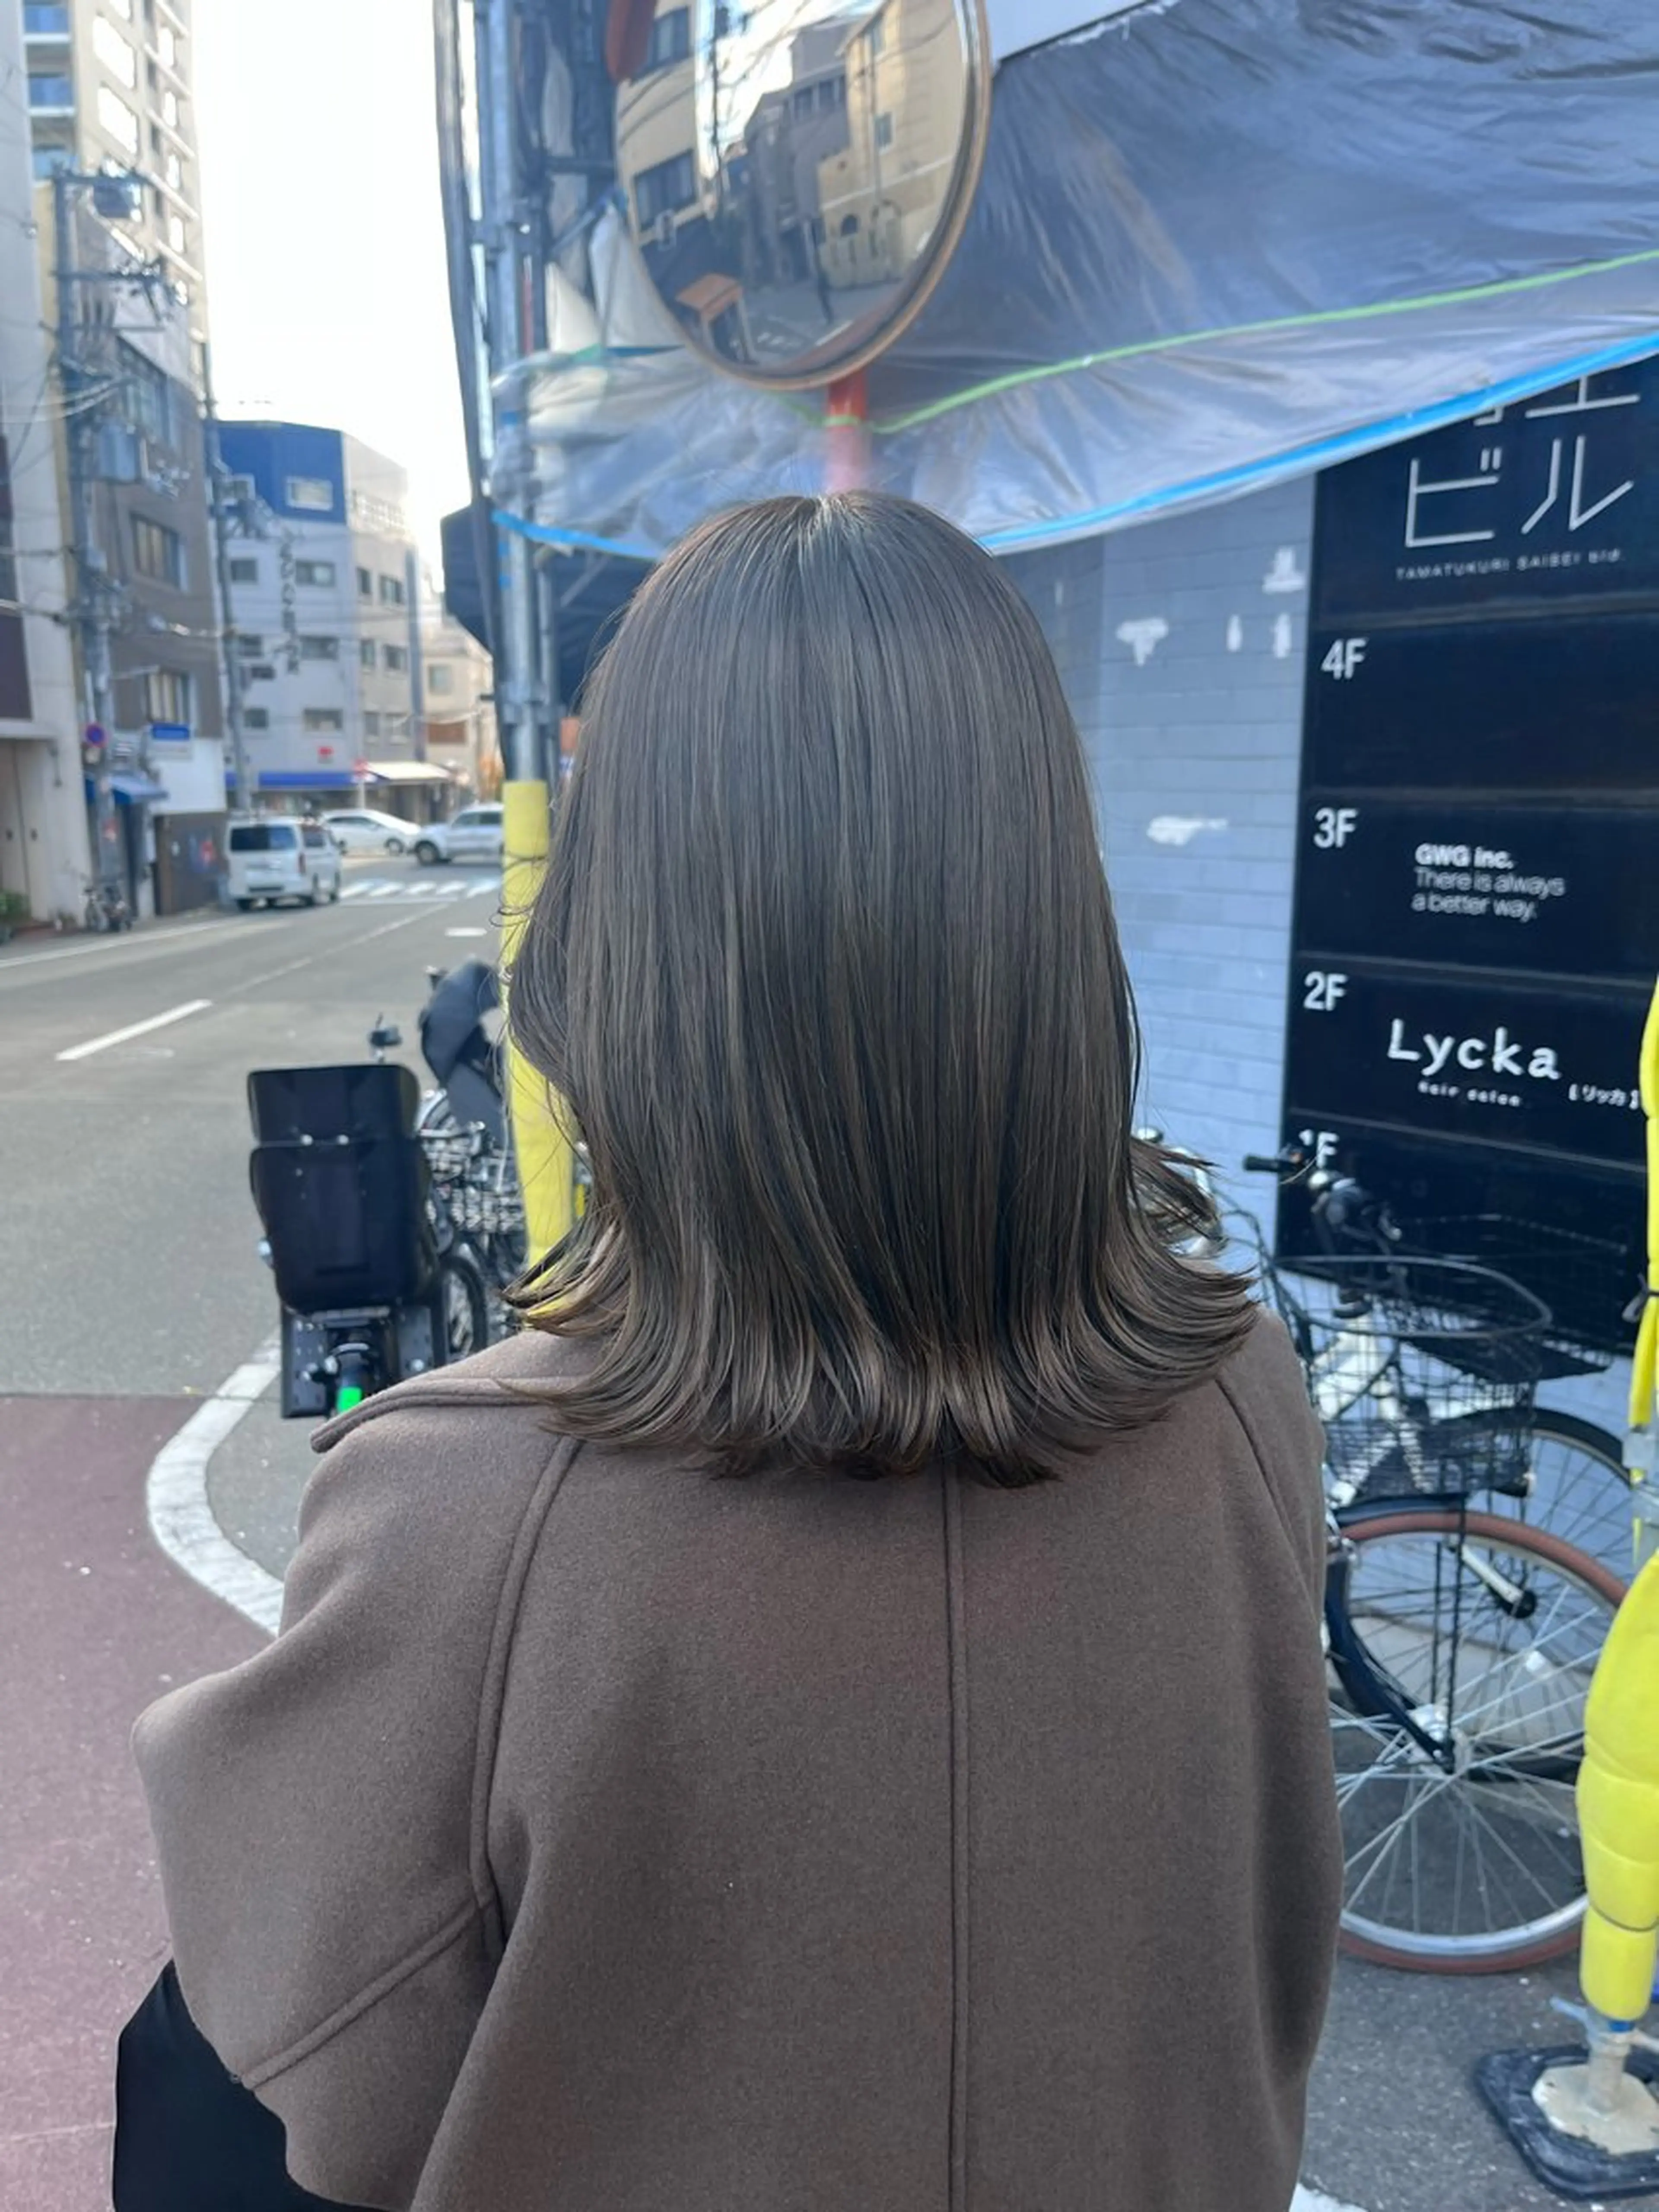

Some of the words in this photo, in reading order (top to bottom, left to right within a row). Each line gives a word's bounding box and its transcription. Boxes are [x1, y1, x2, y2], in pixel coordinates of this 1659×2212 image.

[1405, 435, 1634, 548] ビル
[1320, 637, 1367, 680] 4F
[1313, 807, 1358, 849] 3F
[1415, 843, 1471, 867] GWG
[1411, 893, 1427, 912] a
[1427, 891, 1491, 915] better
[1414, 866, 1472, 891] There
[1474, 870, 1492, 893] is
[1493, 871, 1566, 900] always
[1303, 971, 1347, 1011] 2F
[1387, 1018, 1560, 1080] Lycka
